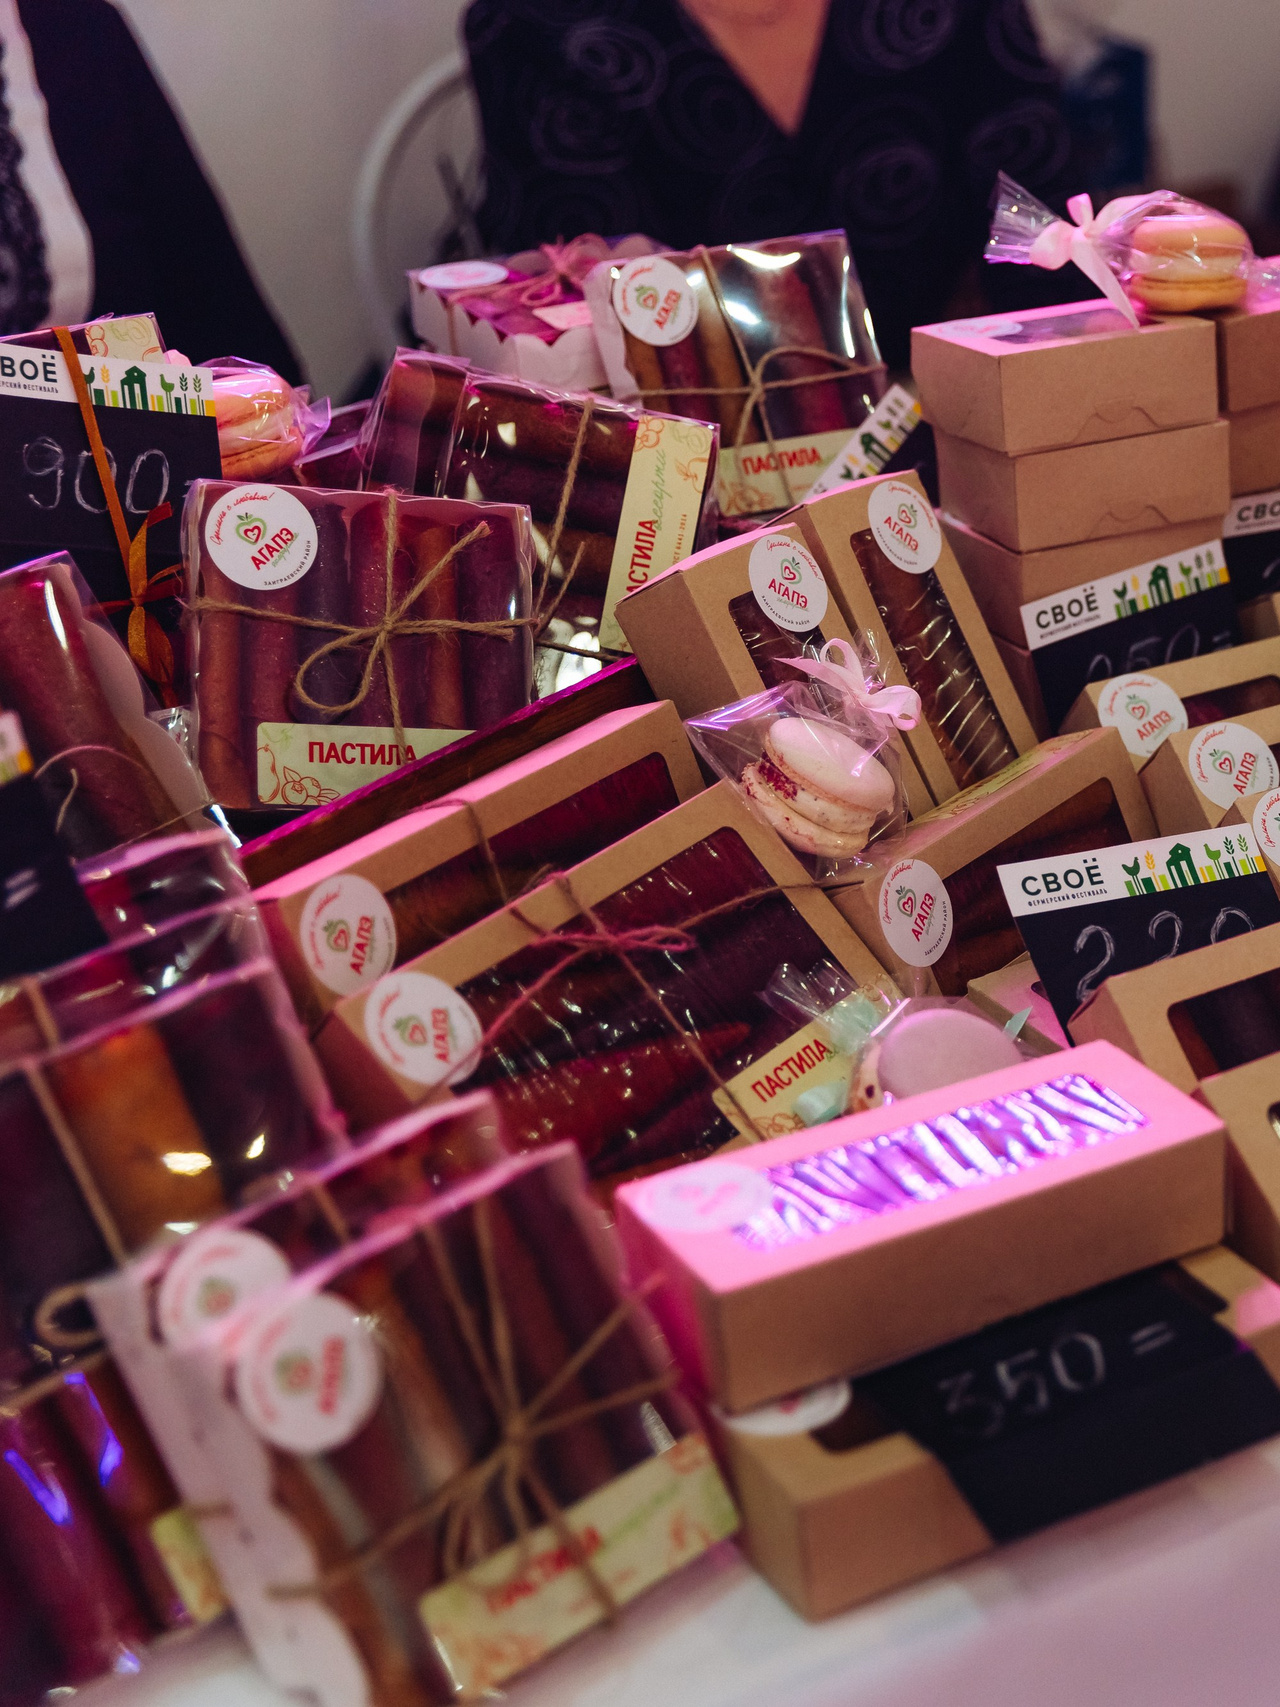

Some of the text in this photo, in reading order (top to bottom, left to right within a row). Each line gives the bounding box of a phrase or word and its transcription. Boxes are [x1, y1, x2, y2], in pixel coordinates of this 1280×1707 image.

[0, 353, 58, 383] ВОЁ
[22, 383, 59, 394] ФЕСТИВАЛЬ
[250, 526, 296, 571] АГАПЭ
[883, 515, 920, 552] АГАПЭ
[263, 560, 306, 587] ЗАИГРАЕВСКИЙ
[303, 540, 312, 561] РАЙОН
[626, 518, 659, 594] АСТИЛА
[767, 577, 809, 609] АГАПЭ
[1035, 586, 1099, 630] СВОЁ
[1136, 710, 1172, 741] АГАПЭ
[308, 741, 418, 766] ПАСТИЛА
[1233, 751, 1257, 796] АГАПЭ
[1020, 857, 1105, 897] СВОЁ
[1028, 888, 1108, 908] ФЕРМЕРСКИЙ ФЕСТИВАЛЬ
[911, 892, 935, 943] АГАПЭ
[349, 914, 375, 977] АГАПЭ
[430, 1007, 453, 1063] АГАПЭ
[750, 1038, 833, 1104] ПАСТИЛА
